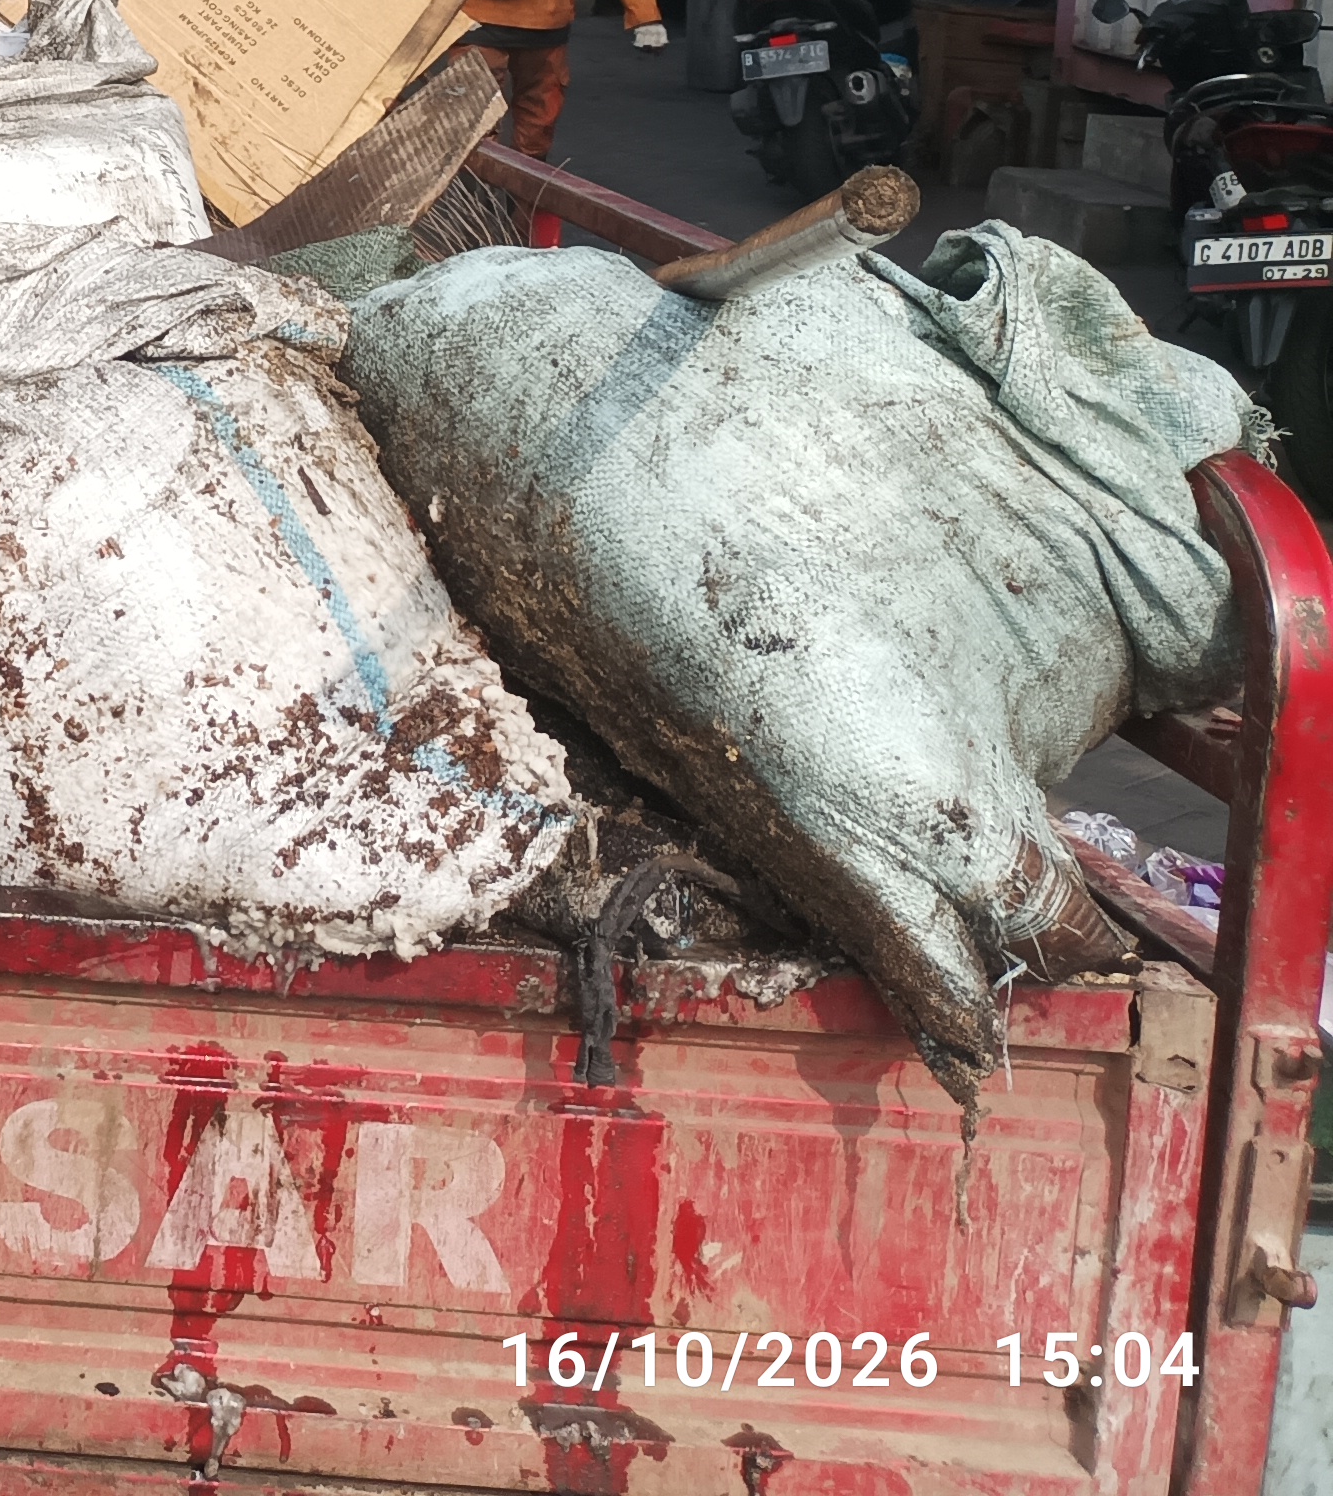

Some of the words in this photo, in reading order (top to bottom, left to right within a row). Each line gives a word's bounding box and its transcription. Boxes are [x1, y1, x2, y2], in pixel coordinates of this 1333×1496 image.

[234, 5, 253, 22] PCS
[246, 1, 261, 14] KG
[198, 10, 222, 31] PART
[266, 18, 278, 29] 26
[294, 18, 308, 31] NO
[223, 15, 257, 46] CASING
[222, 32, 248, 54] PUMP
[307, 30, 345, 62] CARTON
[313, 48, 338, 69] DATE
[744, 53, 754, 66] B
[303, 67, 322, 83] QTY
[313, 62, 330, 76] GW
[251, 78, 265, 91] NO
[281, 75, 306, 98] DESC
[265, 91, 289, 112] PART
[1200, 244, 1211, 263] G
[1221, 241, 1273, 262] 4107
[1283, 239, 1324, 258] ADB
